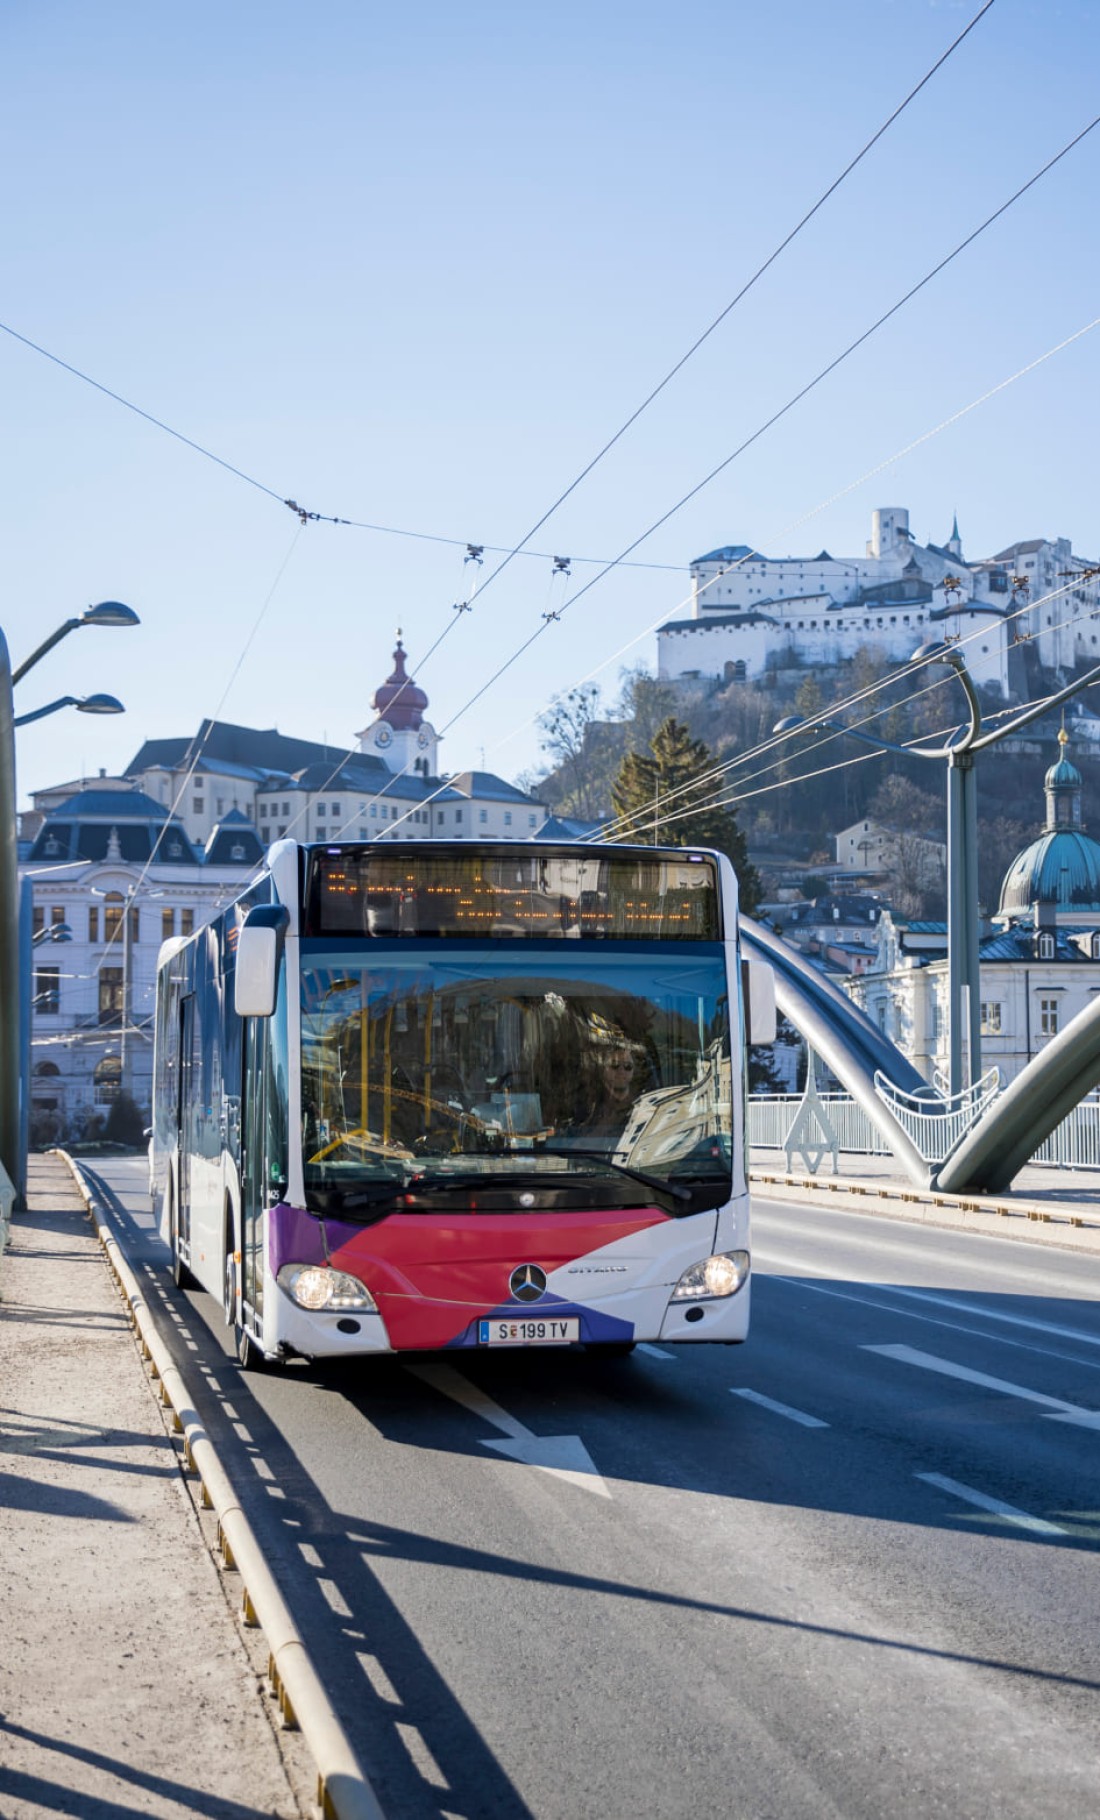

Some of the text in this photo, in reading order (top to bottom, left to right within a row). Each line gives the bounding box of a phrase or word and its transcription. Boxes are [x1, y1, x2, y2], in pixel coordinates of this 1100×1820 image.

[499, 1322, 568, 1339] S 199 TV
